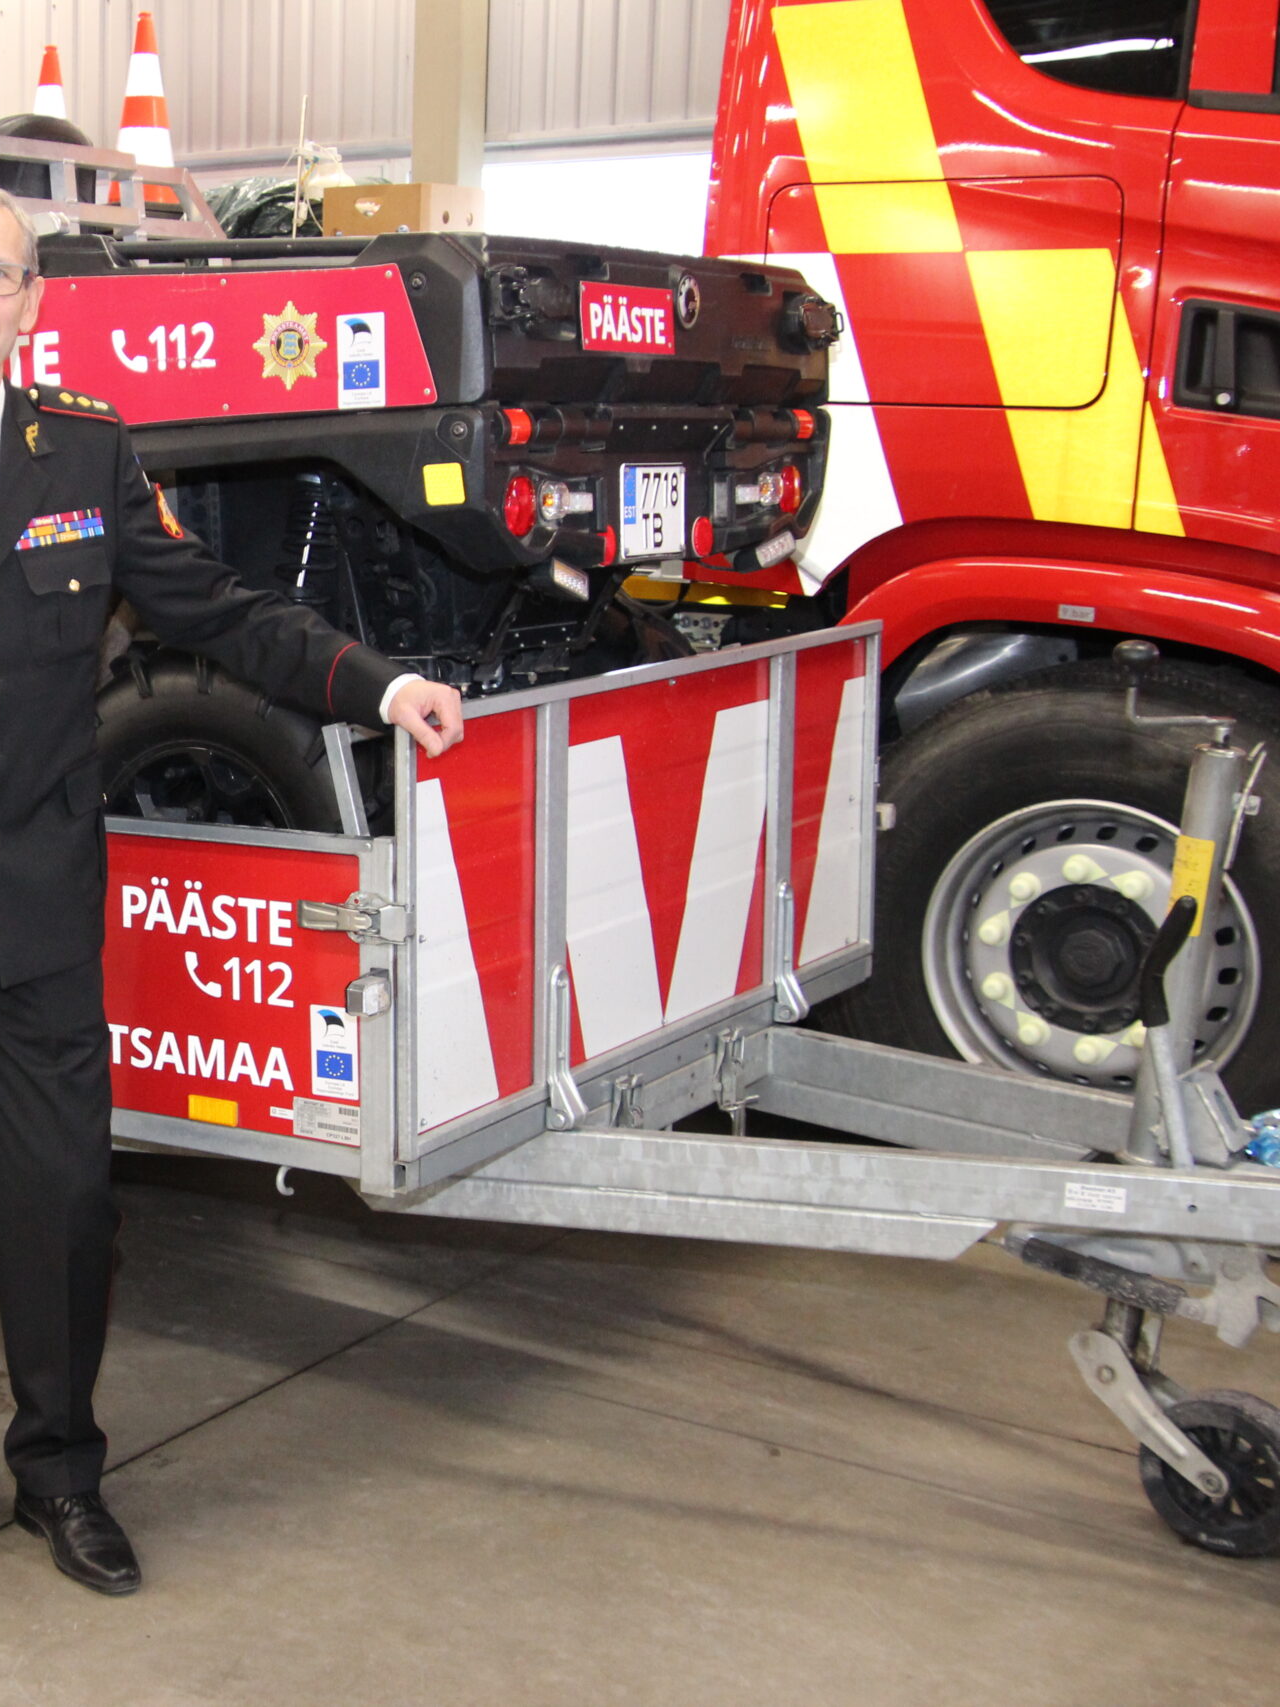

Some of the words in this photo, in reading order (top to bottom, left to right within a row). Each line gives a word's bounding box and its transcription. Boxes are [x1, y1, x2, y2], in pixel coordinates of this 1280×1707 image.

[589, 295, 666, 345] PÄÄSTE
[147, 321, 217, 372] 112
[624, 506, 636, 519] EST
[642, 472, 679, 509] 7718
[642, 513, 664, 549] TB
[122, 876, 293, 947] PÄÄSTE
[223, 957, 294, 1008] 112
[108, 1023, 294, 1091] TSAMAA
